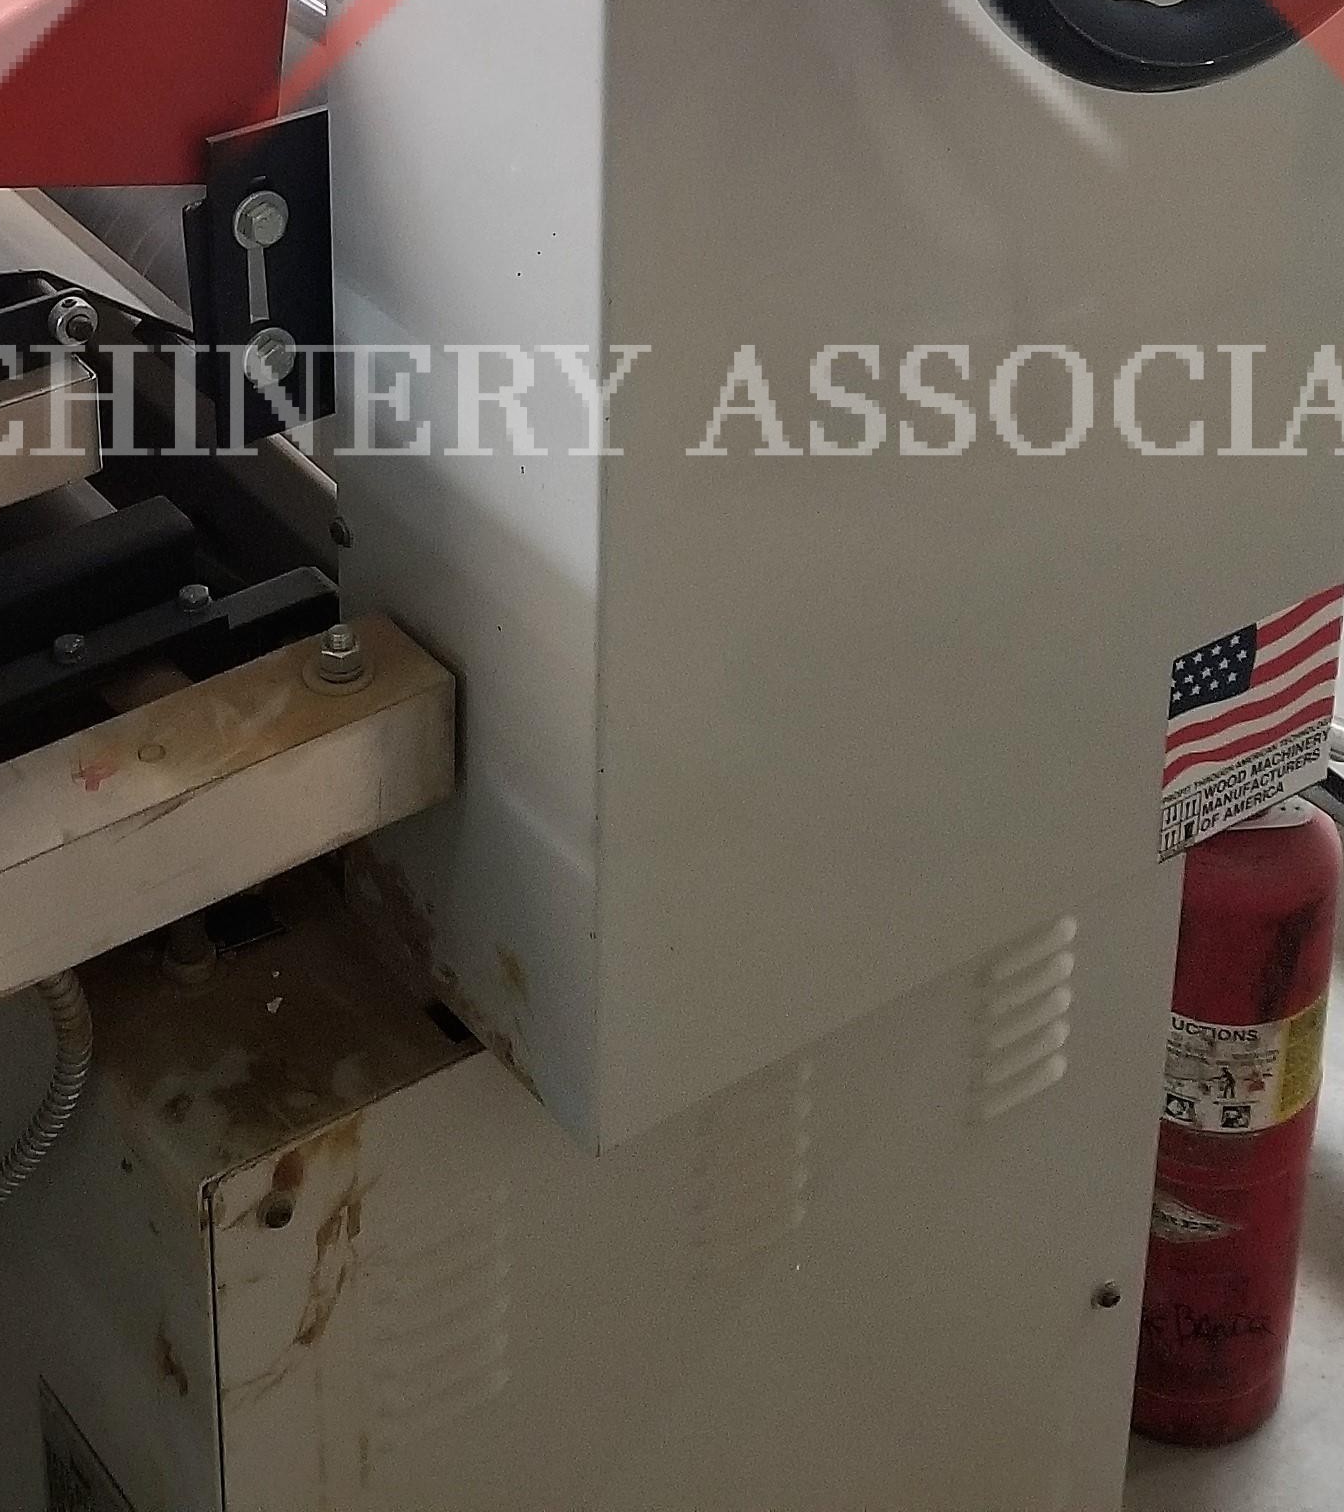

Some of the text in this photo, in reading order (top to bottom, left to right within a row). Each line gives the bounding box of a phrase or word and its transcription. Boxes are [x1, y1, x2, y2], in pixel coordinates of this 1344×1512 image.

[1202, 748, 1321, 816] MANUFACTURERS
[1205, 730, 1330, 799] WOOD MACHINERY
[1200, 781, 1284, 832] OF AMERICA
